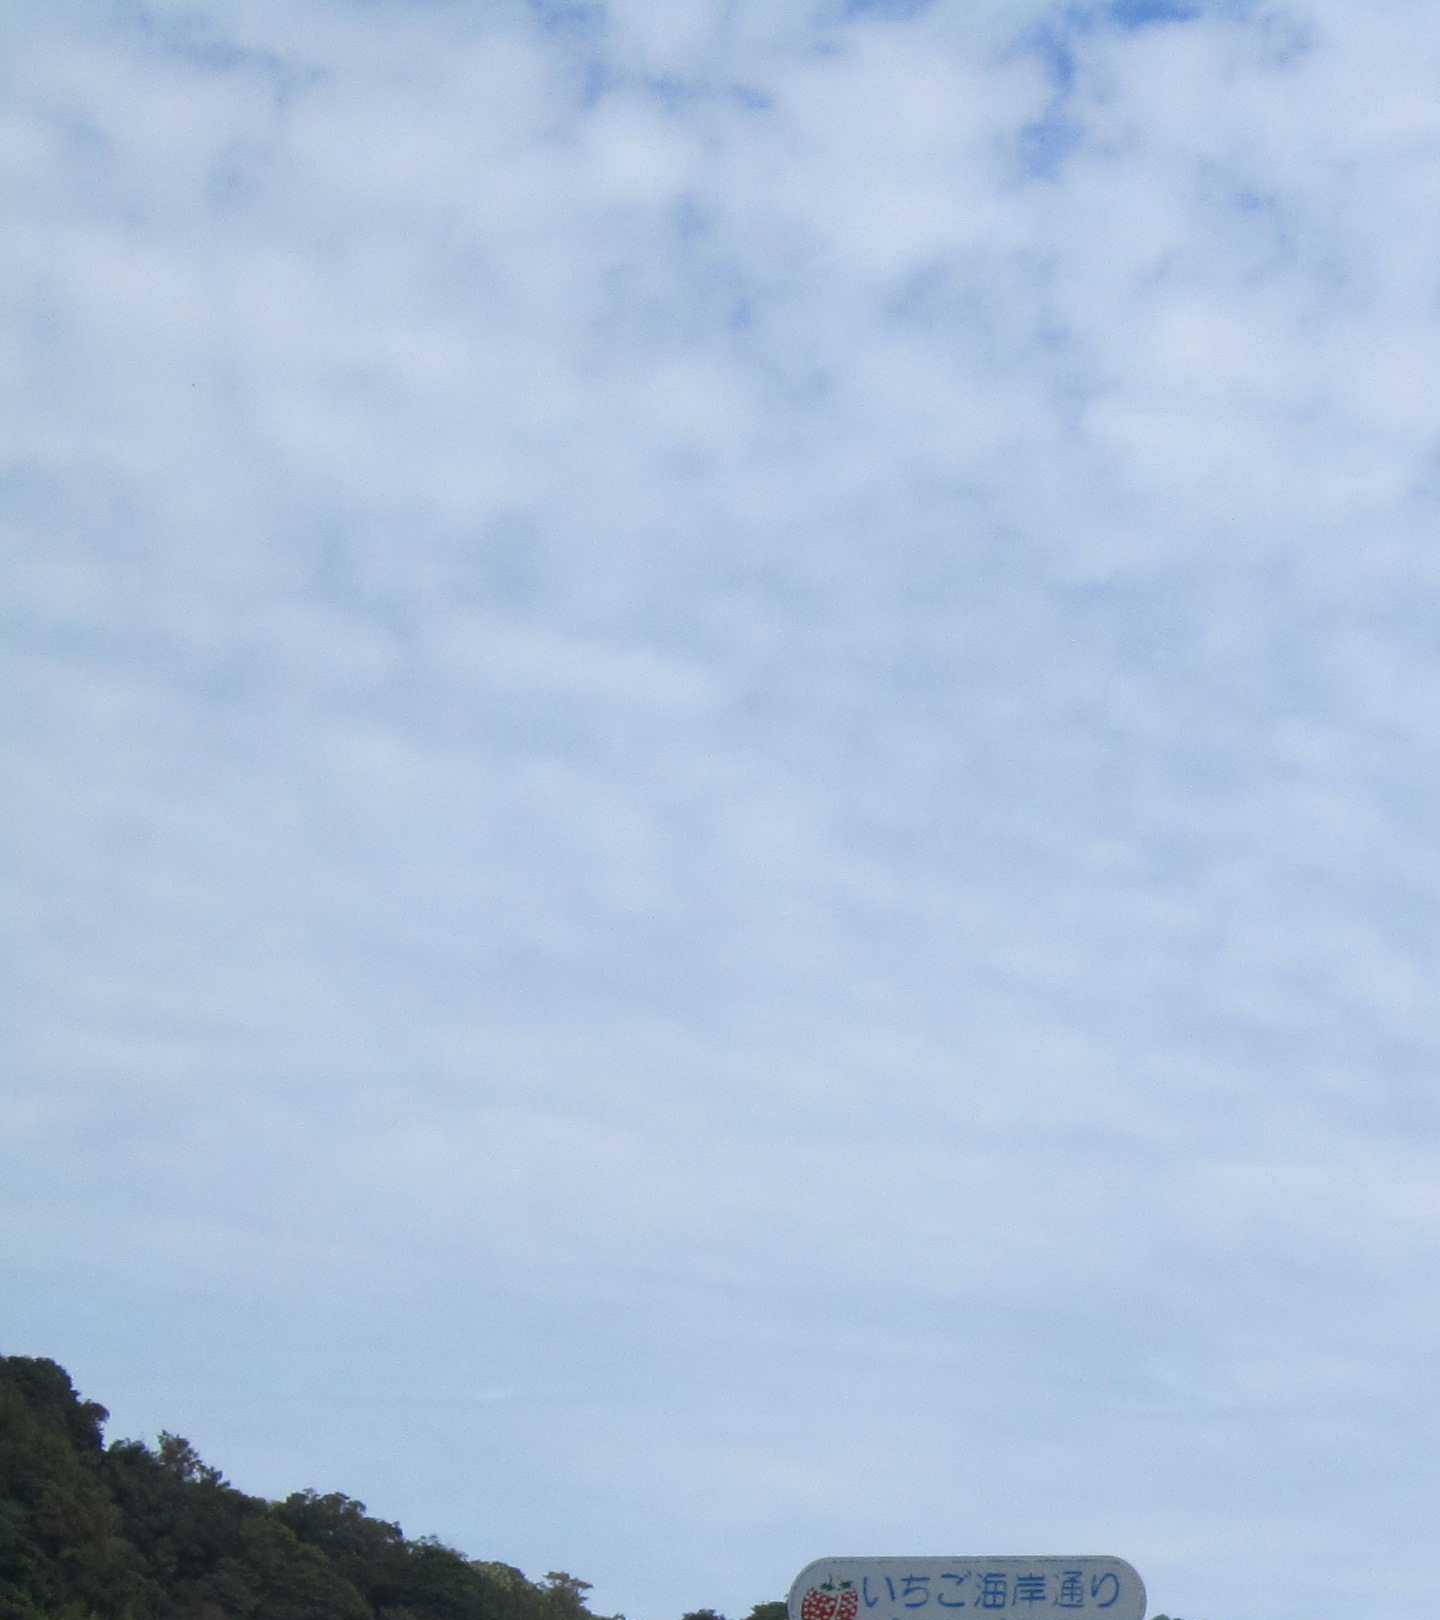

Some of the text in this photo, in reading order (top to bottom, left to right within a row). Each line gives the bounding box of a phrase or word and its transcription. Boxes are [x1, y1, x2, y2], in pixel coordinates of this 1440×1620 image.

[863, 1571, 1119, 1609] いちご海岸通り
